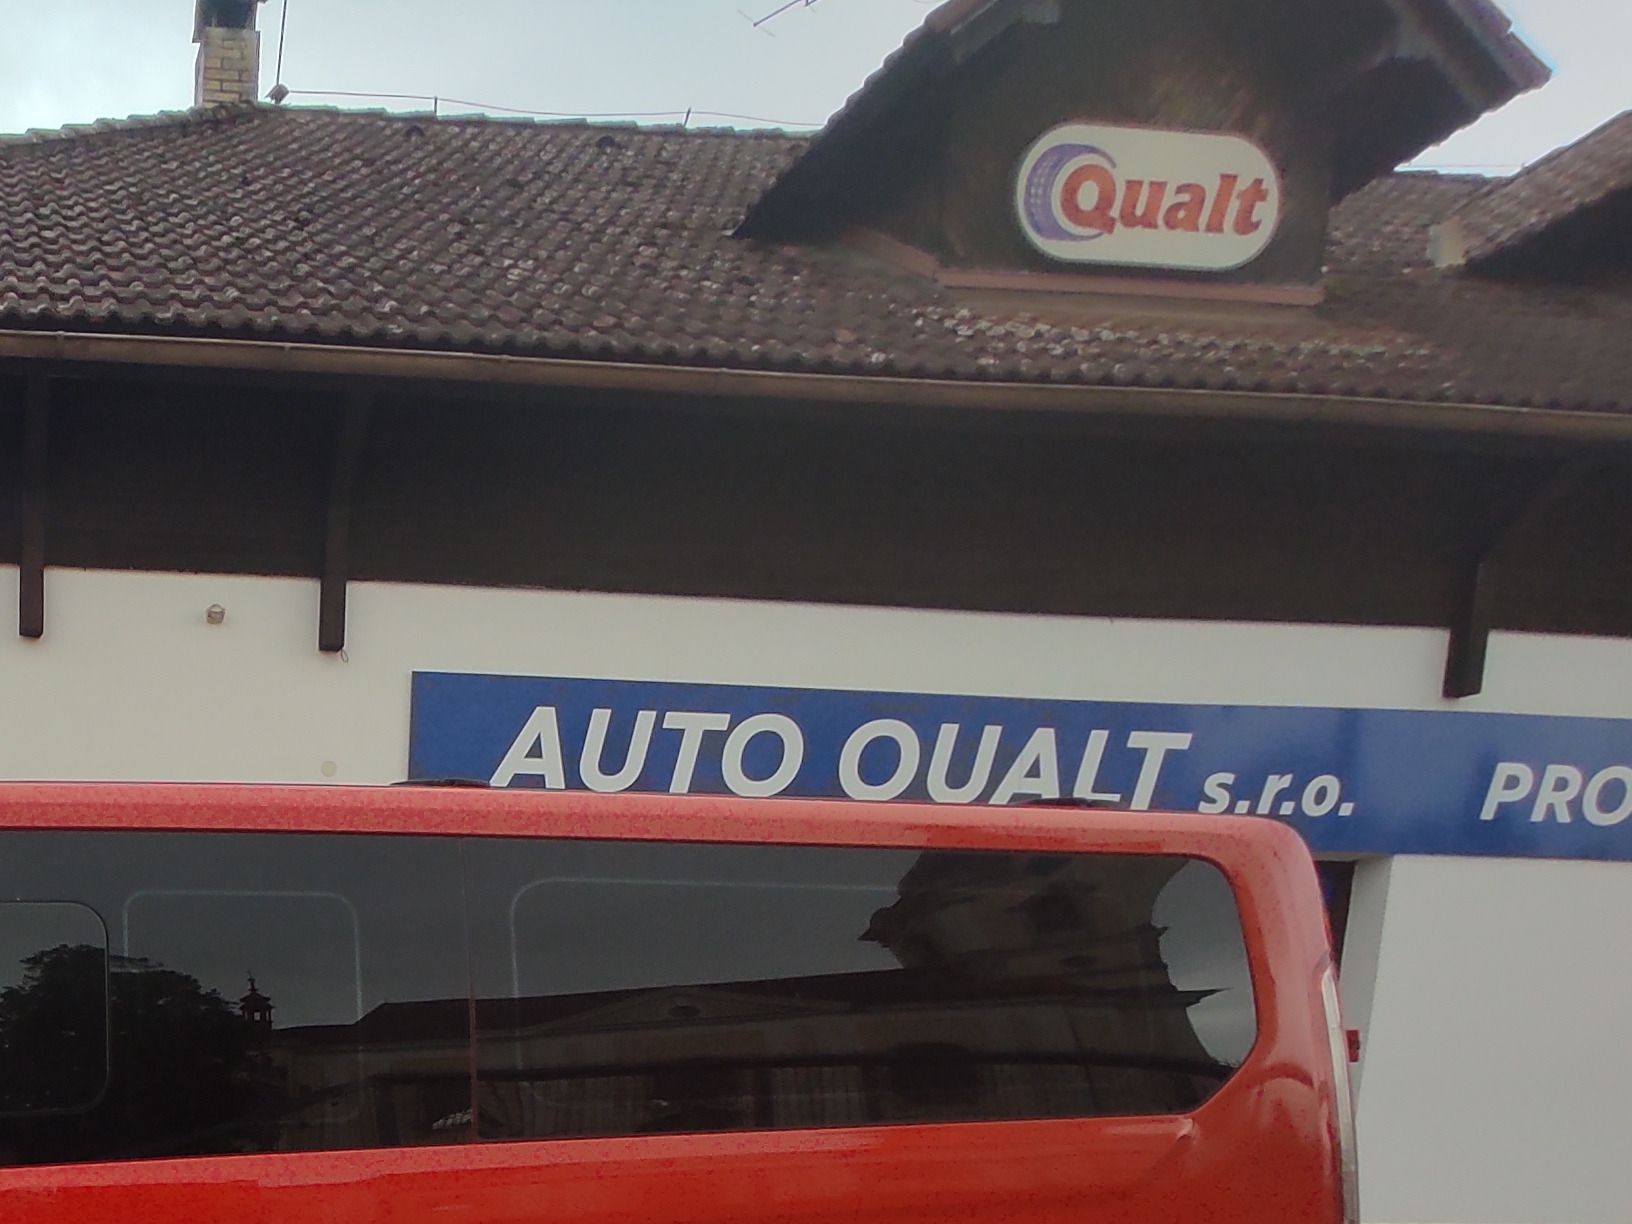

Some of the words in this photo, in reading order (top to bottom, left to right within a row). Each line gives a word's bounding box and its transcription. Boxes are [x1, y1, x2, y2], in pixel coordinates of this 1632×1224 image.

[1060, 163, 1268, 236] Qualt
[489, 706, 805, 798] AUTO
[1198, 772, 1355, 817] s.r.o.
[1479, 762, 1632, 827] PRO
